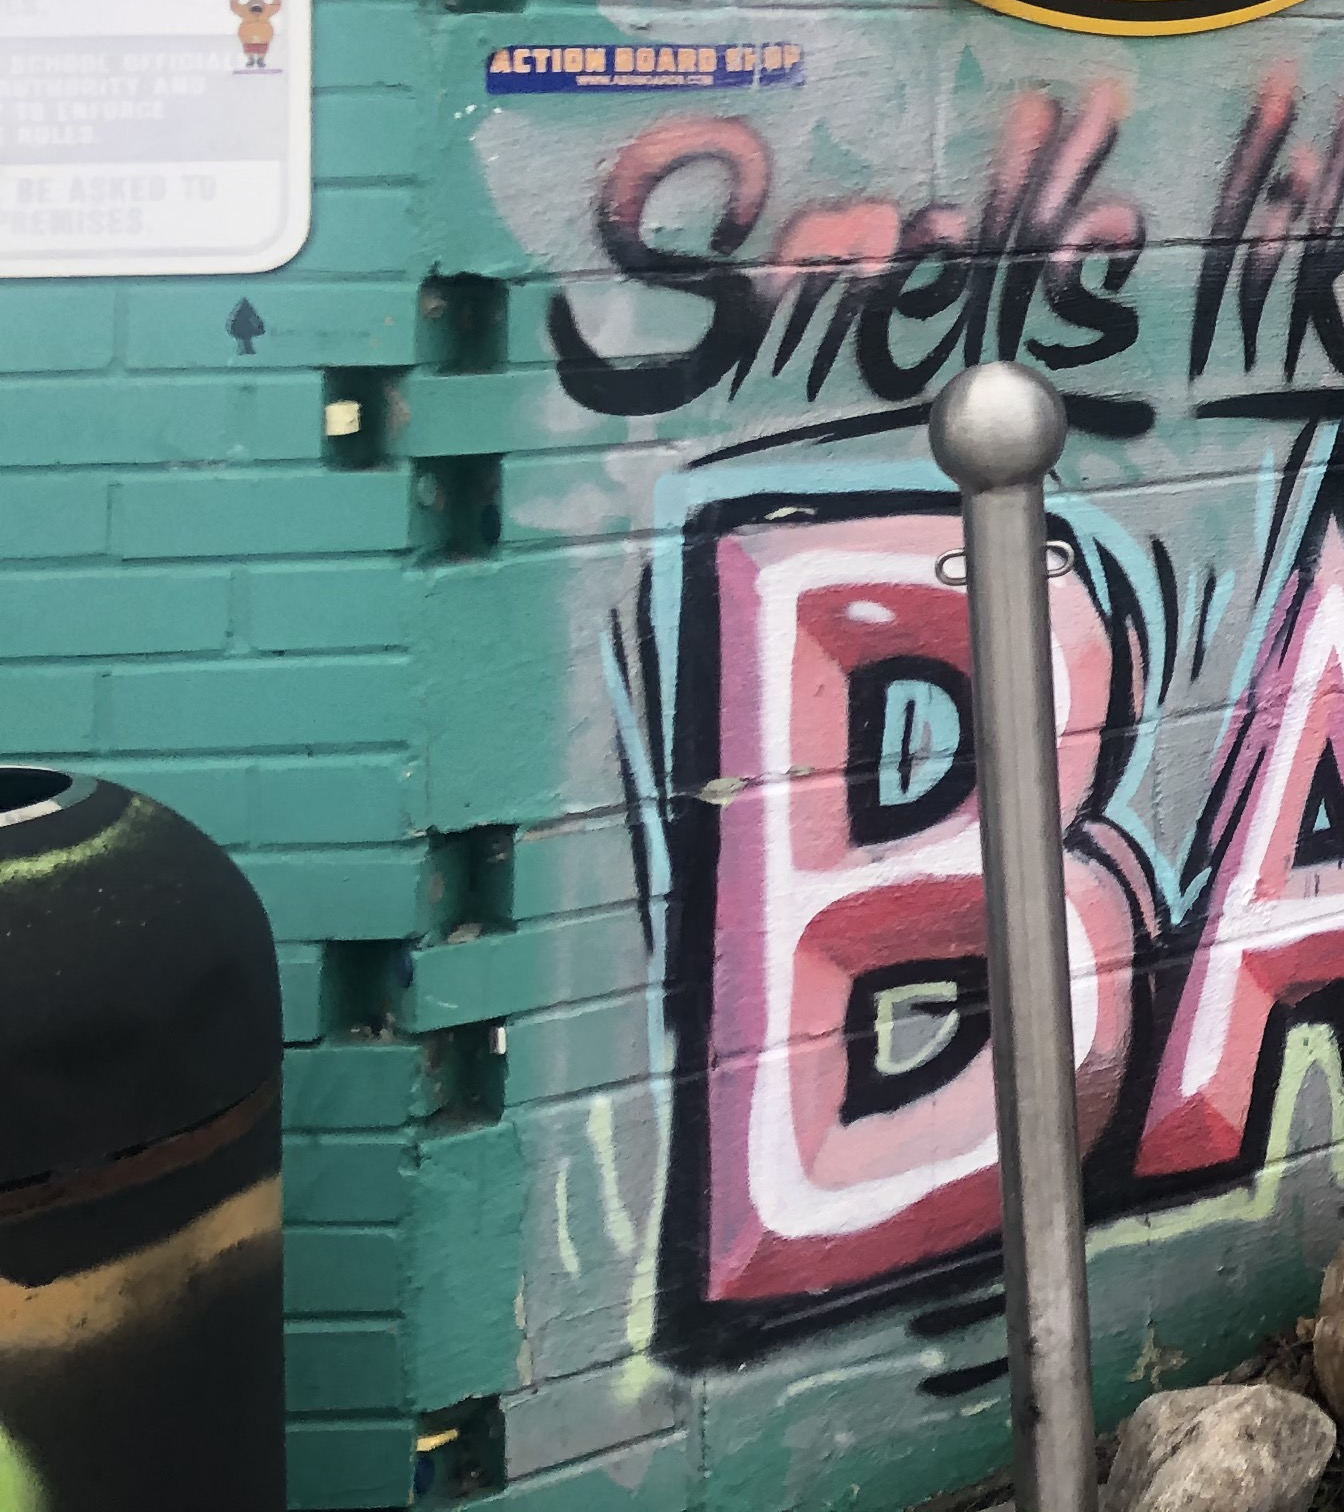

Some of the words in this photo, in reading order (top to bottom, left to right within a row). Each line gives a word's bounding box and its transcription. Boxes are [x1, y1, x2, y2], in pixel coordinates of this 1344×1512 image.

[490, 47, 606, 73] ACTION
[614, 47, 717, 73] BOARD
[547, 76, 1149, 418] Smells
